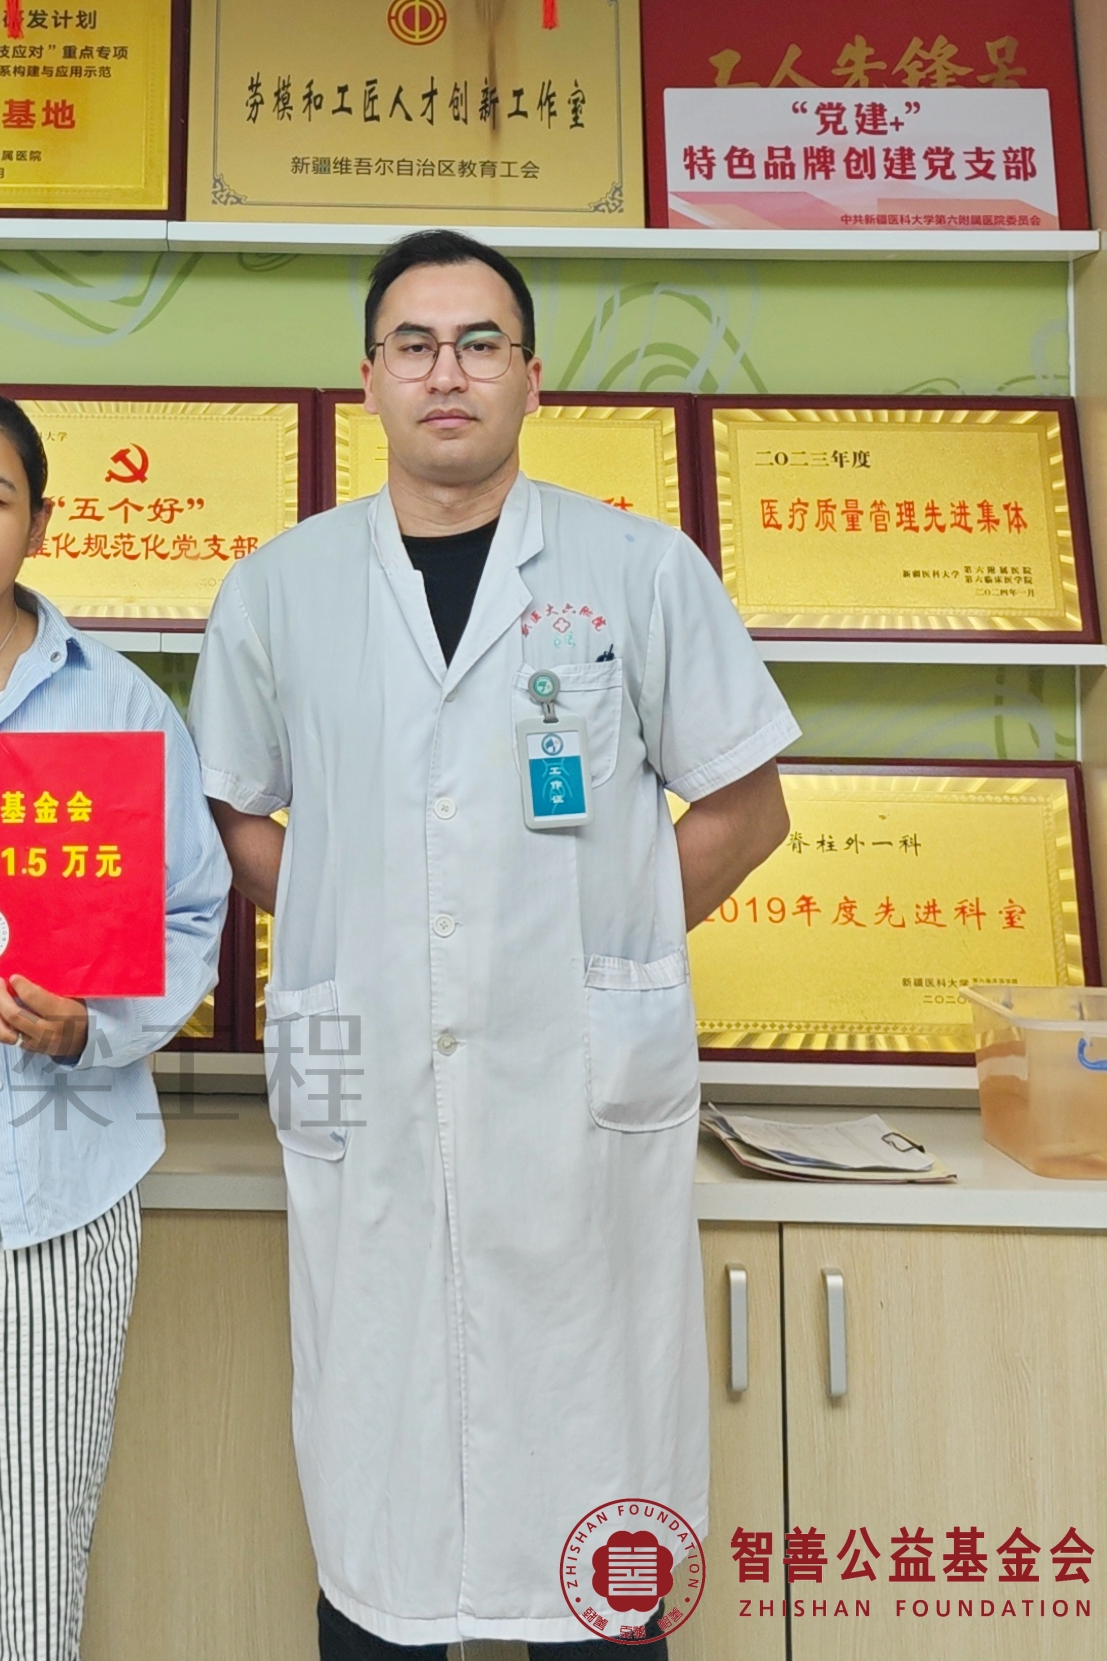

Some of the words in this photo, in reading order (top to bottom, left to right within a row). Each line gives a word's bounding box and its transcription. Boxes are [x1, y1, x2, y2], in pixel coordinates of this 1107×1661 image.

[245, 71, 587, 130] 劳模和工匠人才创新工作室
[290, 156, 540, 180] 新疆维吾尔自治区教育工会
[683, 145, 1038, 182] 特色品牌创建党支部
[840, 213, 1042, 227] 中共新疆医科大学第六附属医院委员会
[39, 431, 68, 442] 大学
[760, 498, 1028, 534] 医疗质量管理先进集体
[787, 832, 922, 857] 脊柱外一科
[62, 845, 122, 878] 万元
